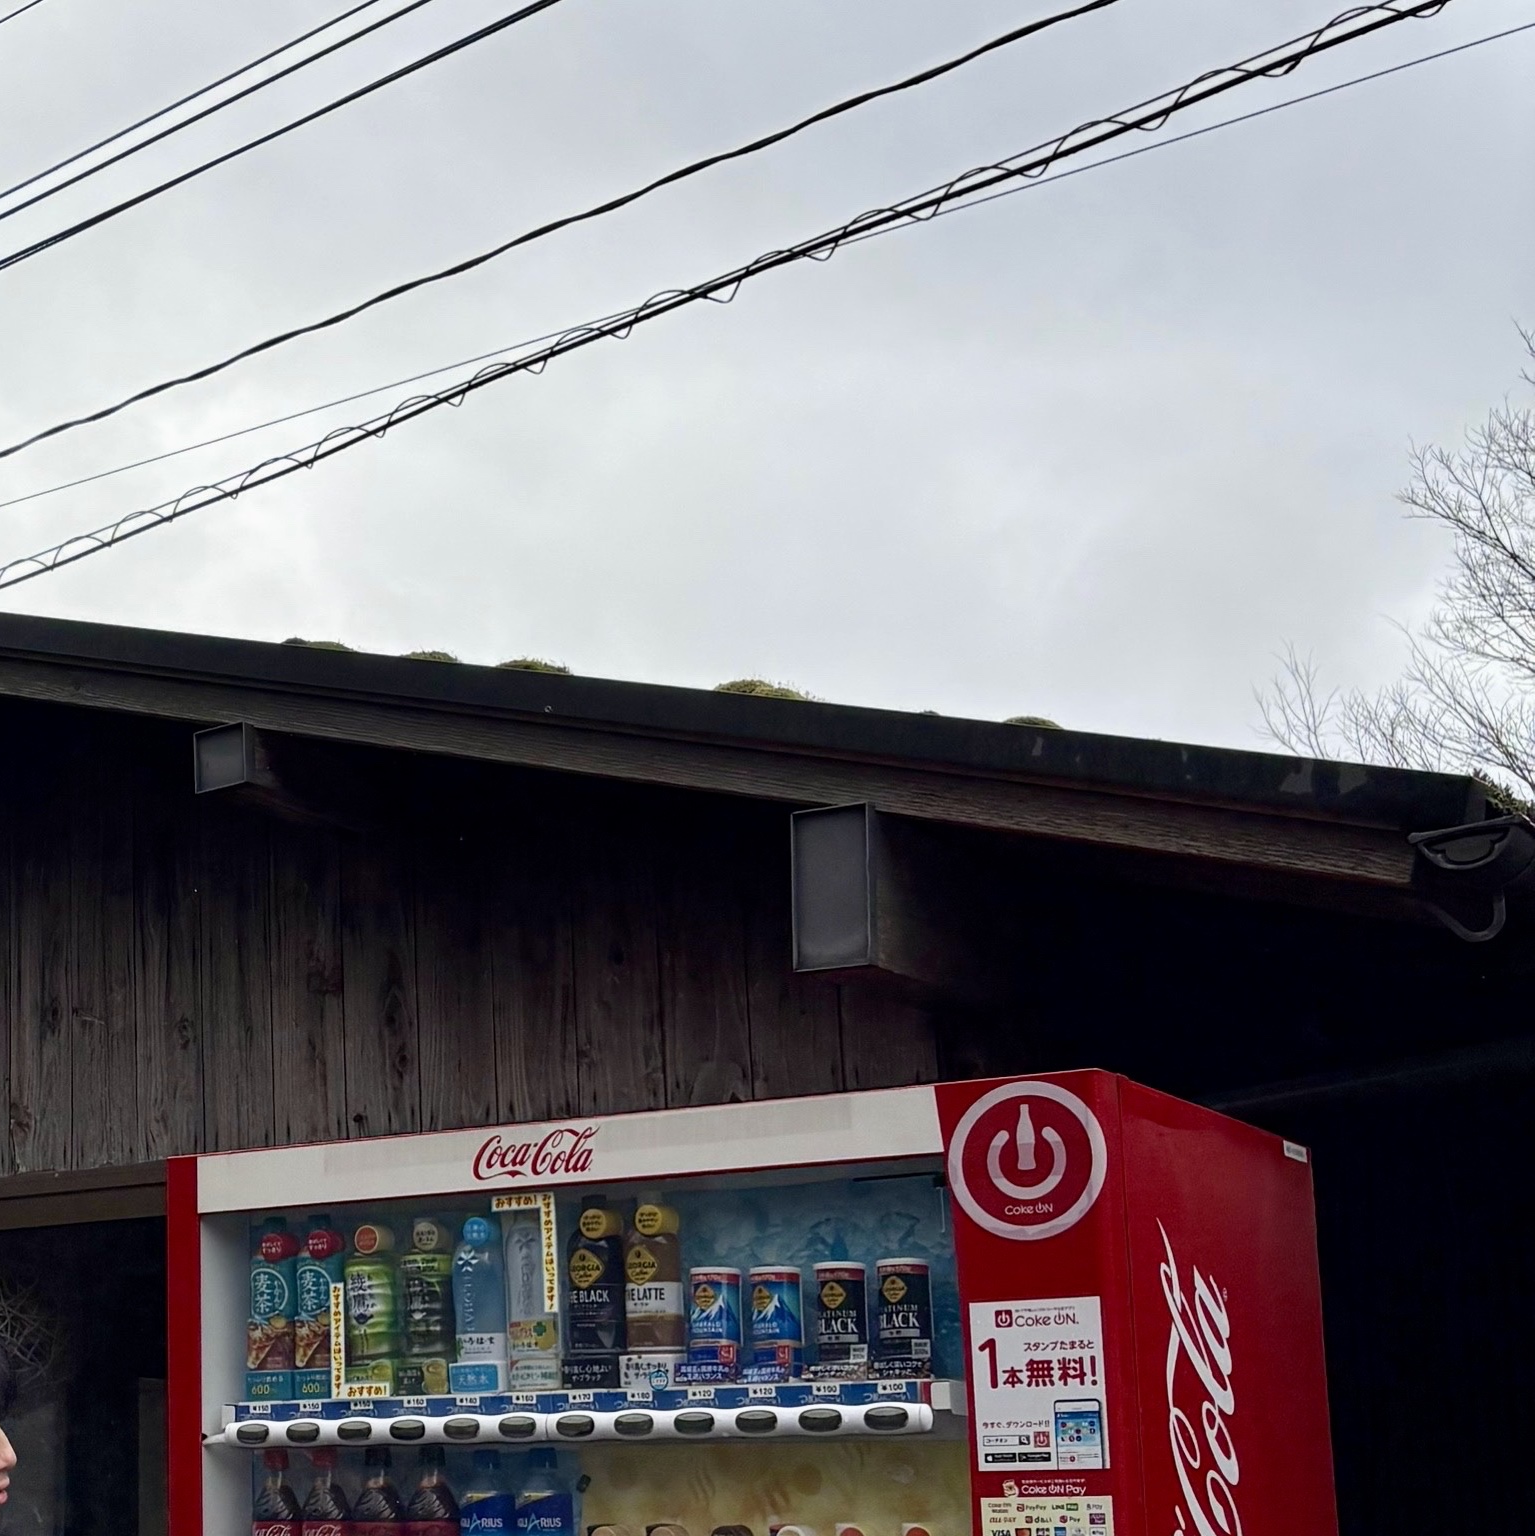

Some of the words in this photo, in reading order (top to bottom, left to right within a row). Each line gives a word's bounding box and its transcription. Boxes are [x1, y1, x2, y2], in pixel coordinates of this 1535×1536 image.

[472, 1128, 592, 1180] Coca-Cola
[1004, 1203, 1035, 1216] Coke
[1035, 1201, 1054, 1215] ON
[254, 1273, 273, 1313] 麦茶
[300, 1271, 319, 1311] 麦茶
[579, 1289, 610, 1303] BLACK
[637, 1287, 665, 1301] LATTE
[1015, 1314, 1052, 1328] Coke
[1023, 1340, 1095, 1352] スタンプたまると
[978, 1338, 1098, 1389] 1本無料!
[458, 1373, 490, 1385] 天然水
[347, 1385, 388, 1397] おすすめ!
[1021, 1485, 1047, 1494] Coke
[1066, 1484, 1086, 1496] Pay
[991, 1529, 1011, 1536] VISA
